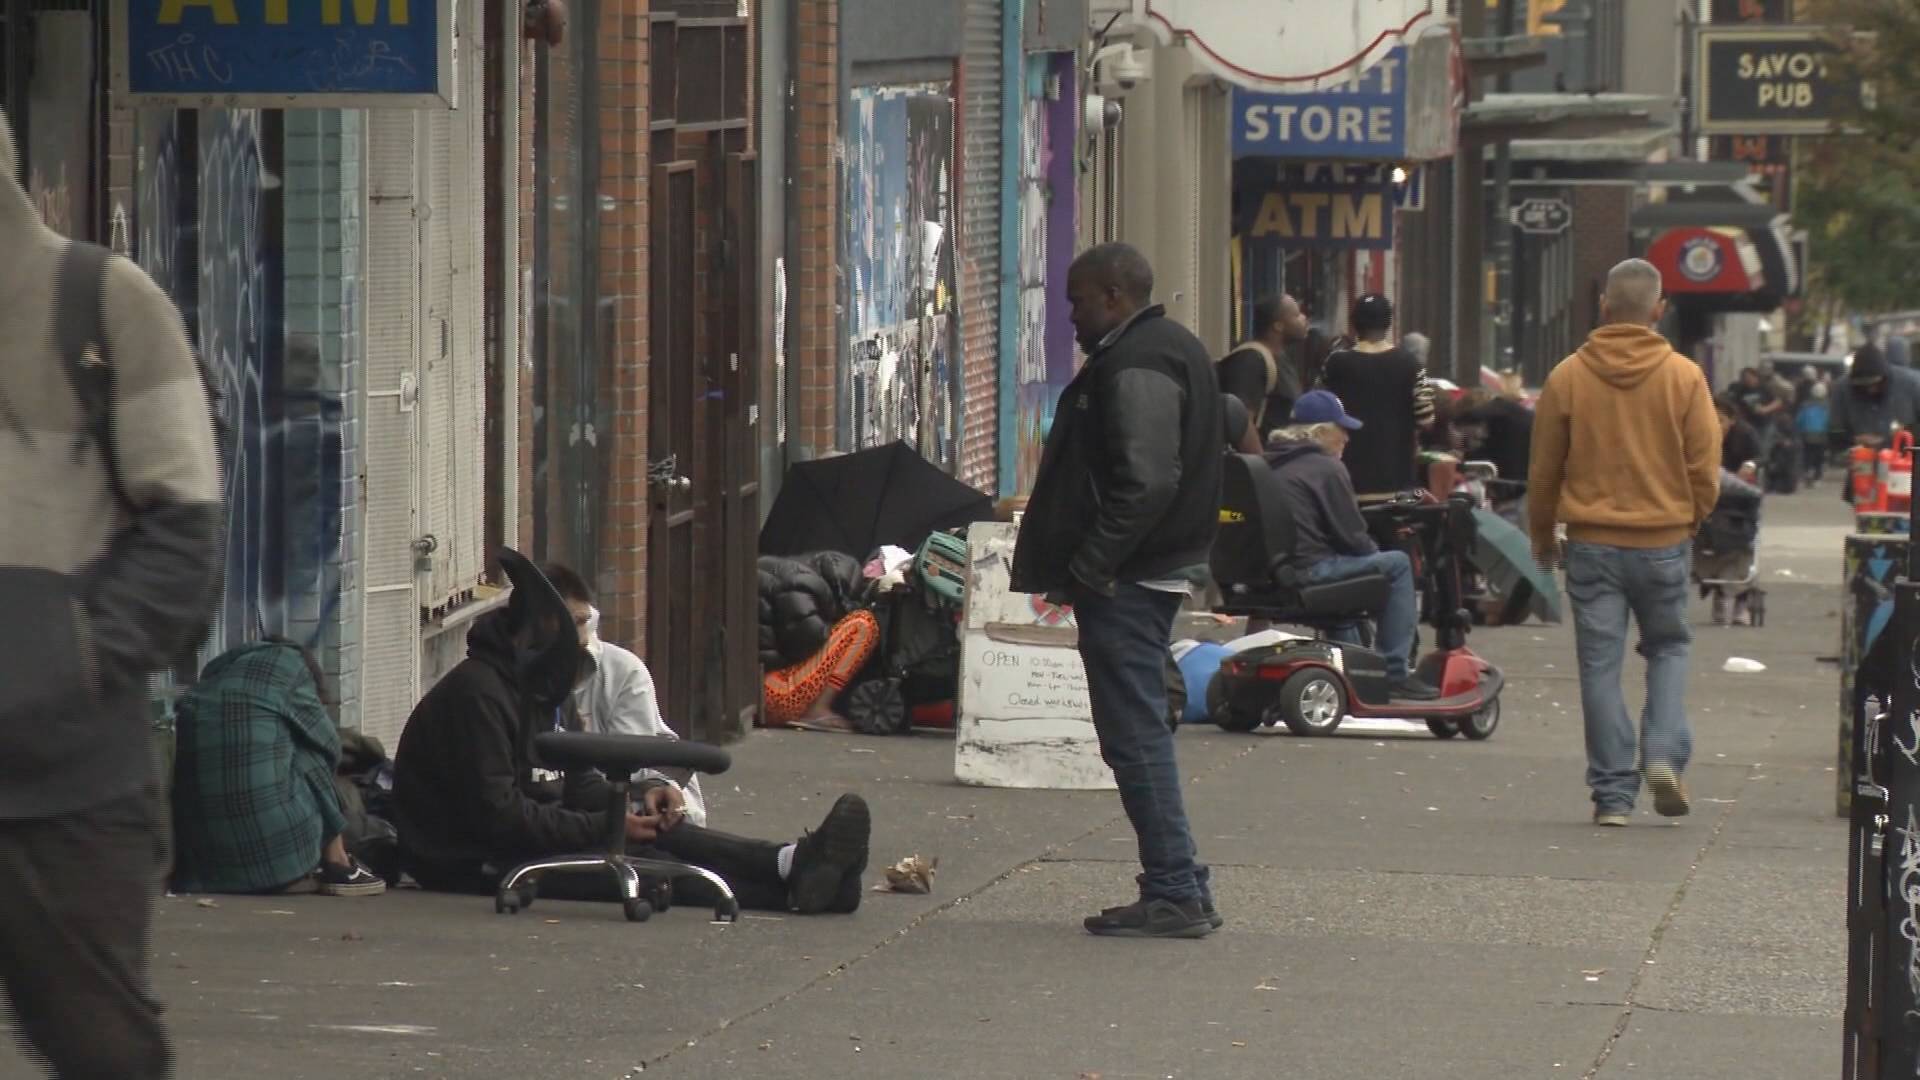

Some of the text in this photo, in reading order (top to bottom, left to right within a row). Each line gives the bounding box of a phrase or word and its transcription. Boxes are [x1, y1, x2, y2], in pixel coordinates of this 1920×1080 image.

[1758, 82, 1814, 108] PUB
[1245, 105, 1393, 142] STORE
[1251, 192, 1382, 239] ATM
[982, 650, 1020, 667] OPEN
